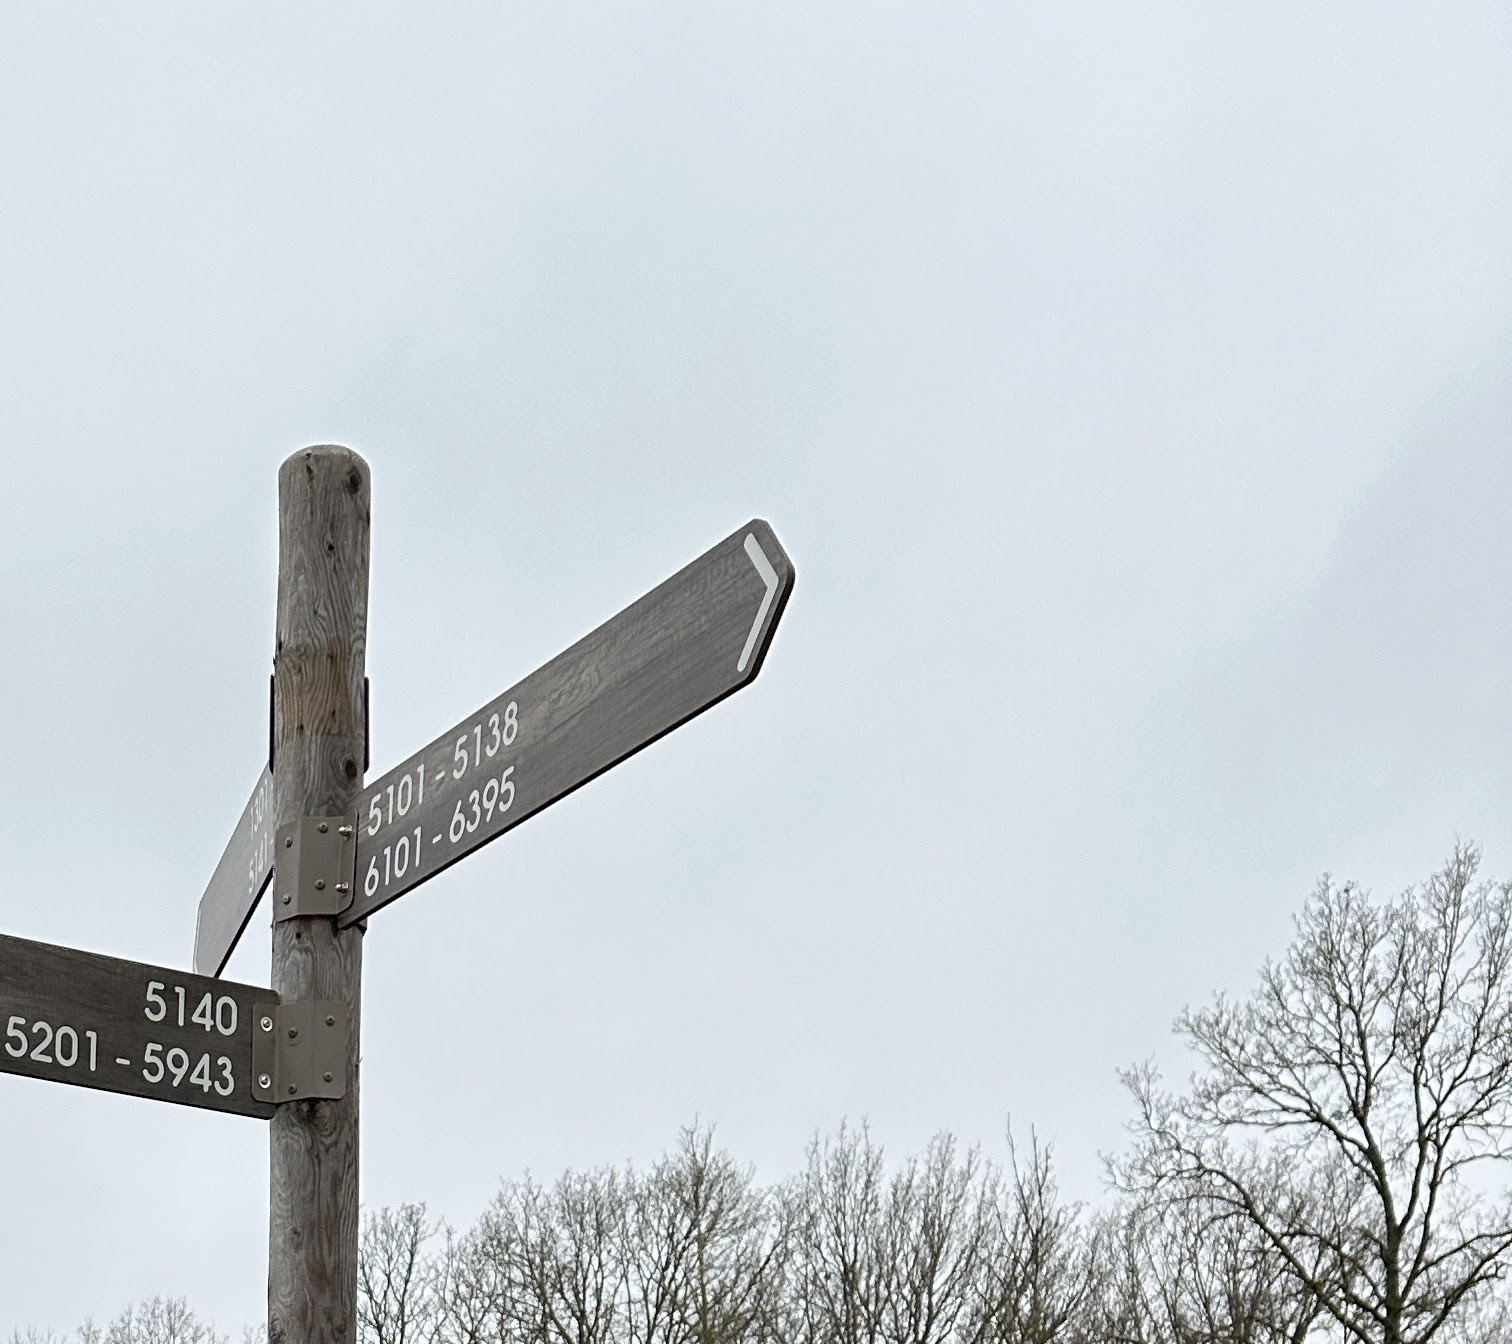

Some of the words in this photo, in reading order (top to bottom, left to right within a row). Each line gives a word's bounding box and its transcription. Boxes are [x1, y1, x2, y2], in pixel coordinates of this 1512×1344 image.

[366, 763, 425, 837] 5101
[452, 701, 519, 780] 5138
[364, 826, 422, 897] 6101
[449, 765, 516, 844] 6395
[4, 1015, 97, 1072] 5201
[142, 1042, 235, 1096] 5943
[144, 981, 238, 1036] 5140
